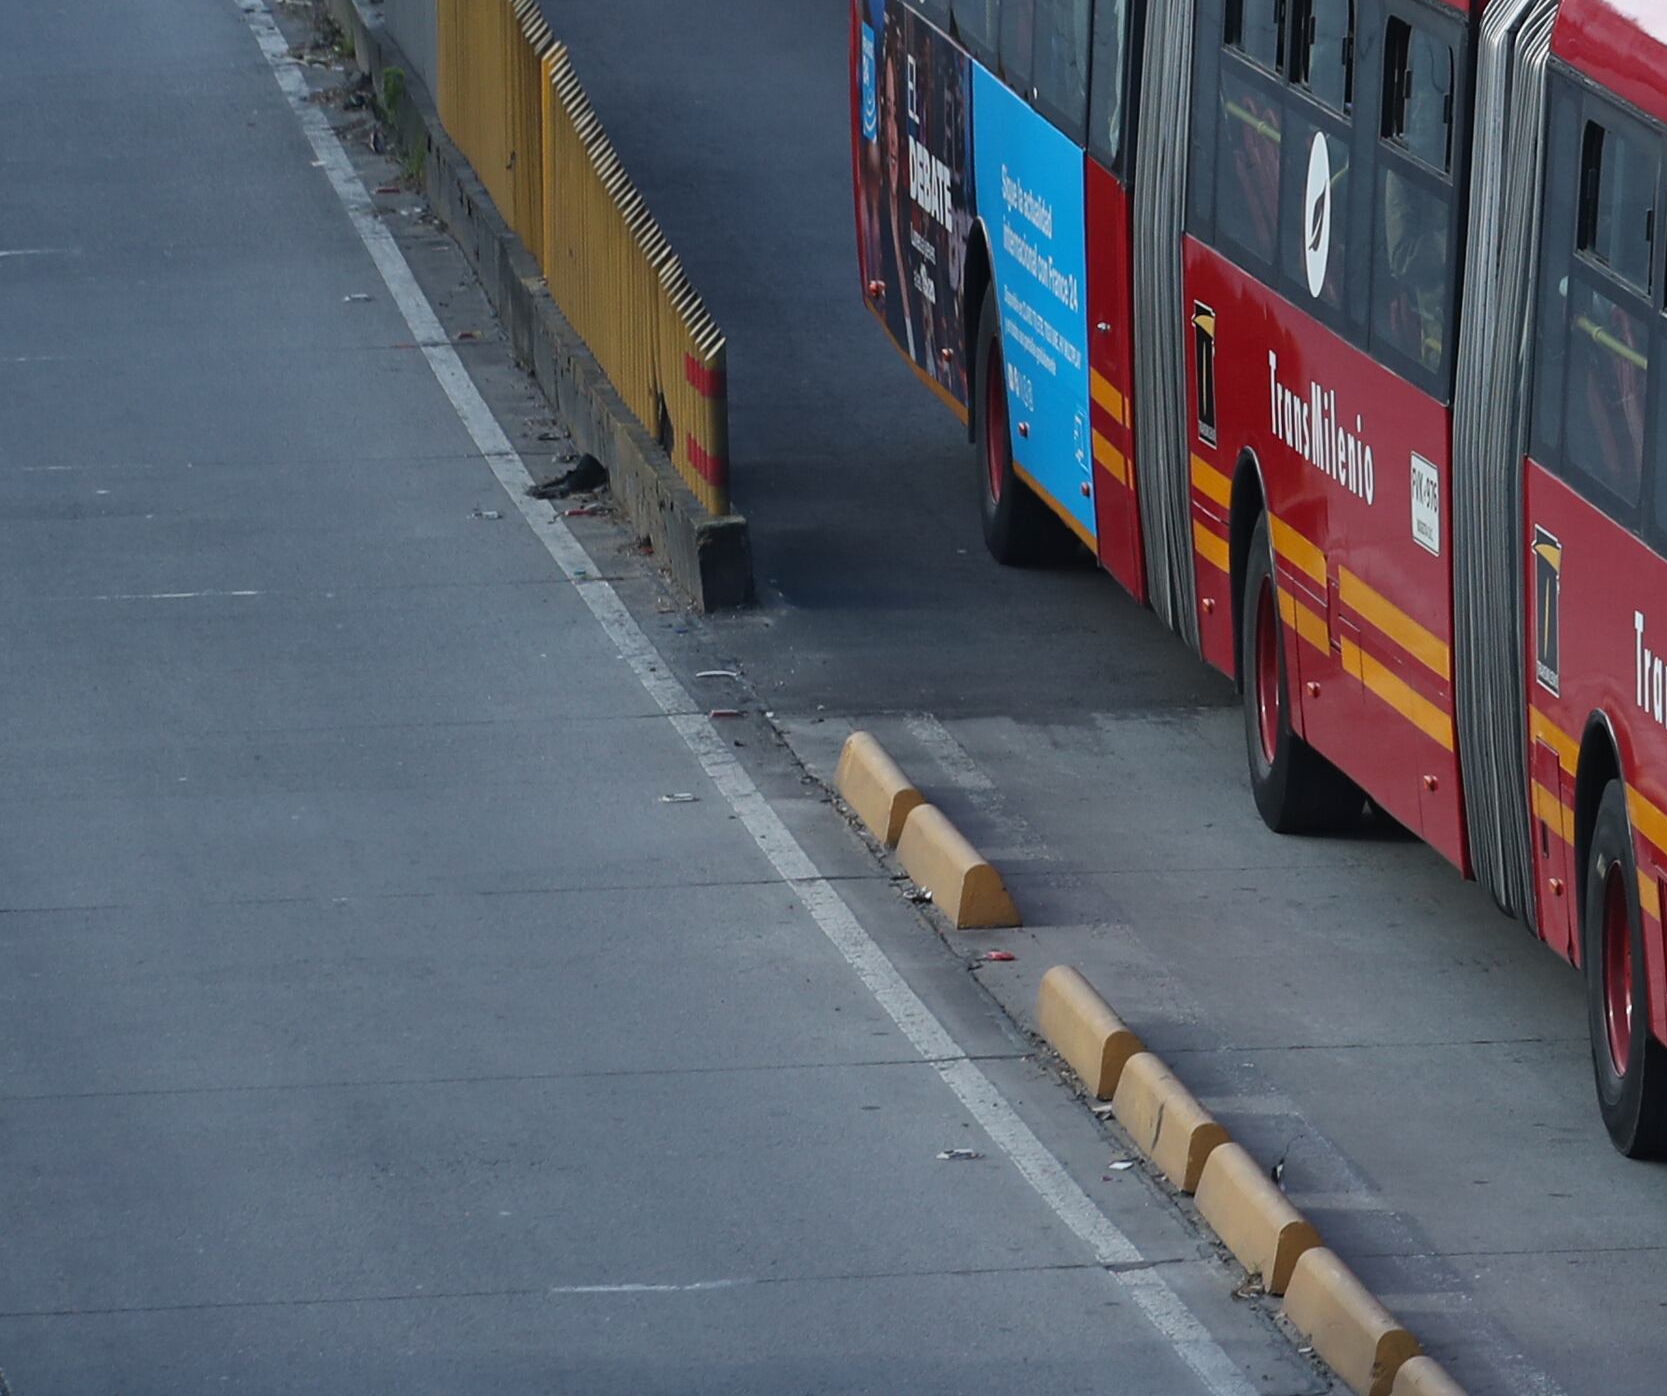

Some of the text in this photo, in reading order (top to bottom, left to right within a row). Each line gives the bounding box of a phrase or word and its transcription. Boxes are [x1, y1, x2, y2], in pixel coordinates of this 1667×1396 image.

[908, 54, 920, 125] EL
[908, 134, 953, 234] DEBATE
[1269, 350, 1375, 506] TransMilenio
